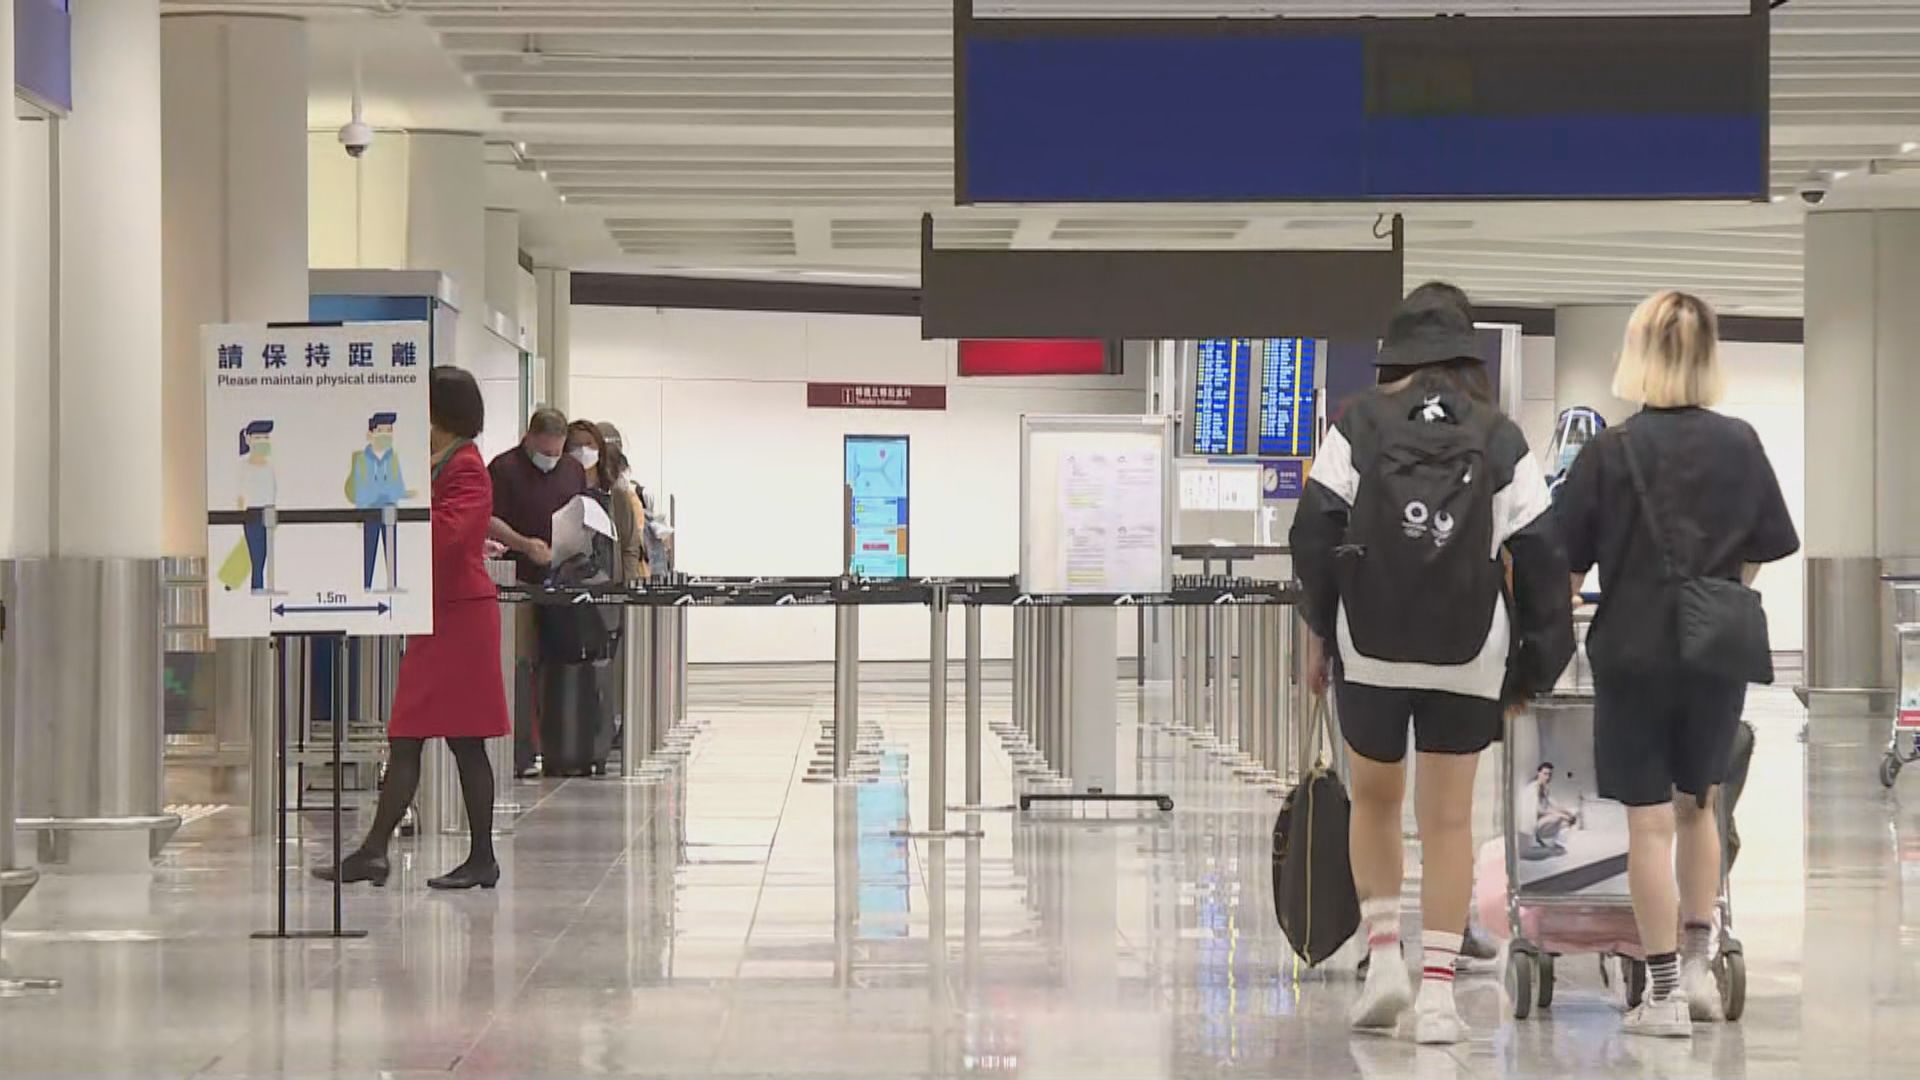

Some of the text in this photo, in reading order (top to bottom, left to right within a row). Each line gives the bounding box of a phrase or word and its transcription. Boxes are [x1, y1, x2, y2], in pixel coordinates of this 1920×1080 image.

[217, 342, 417, 369] 請保持距離
[218, 372, 416, 387] Please maintain physical distance
[316, 592, 347, 604] 1.5m
